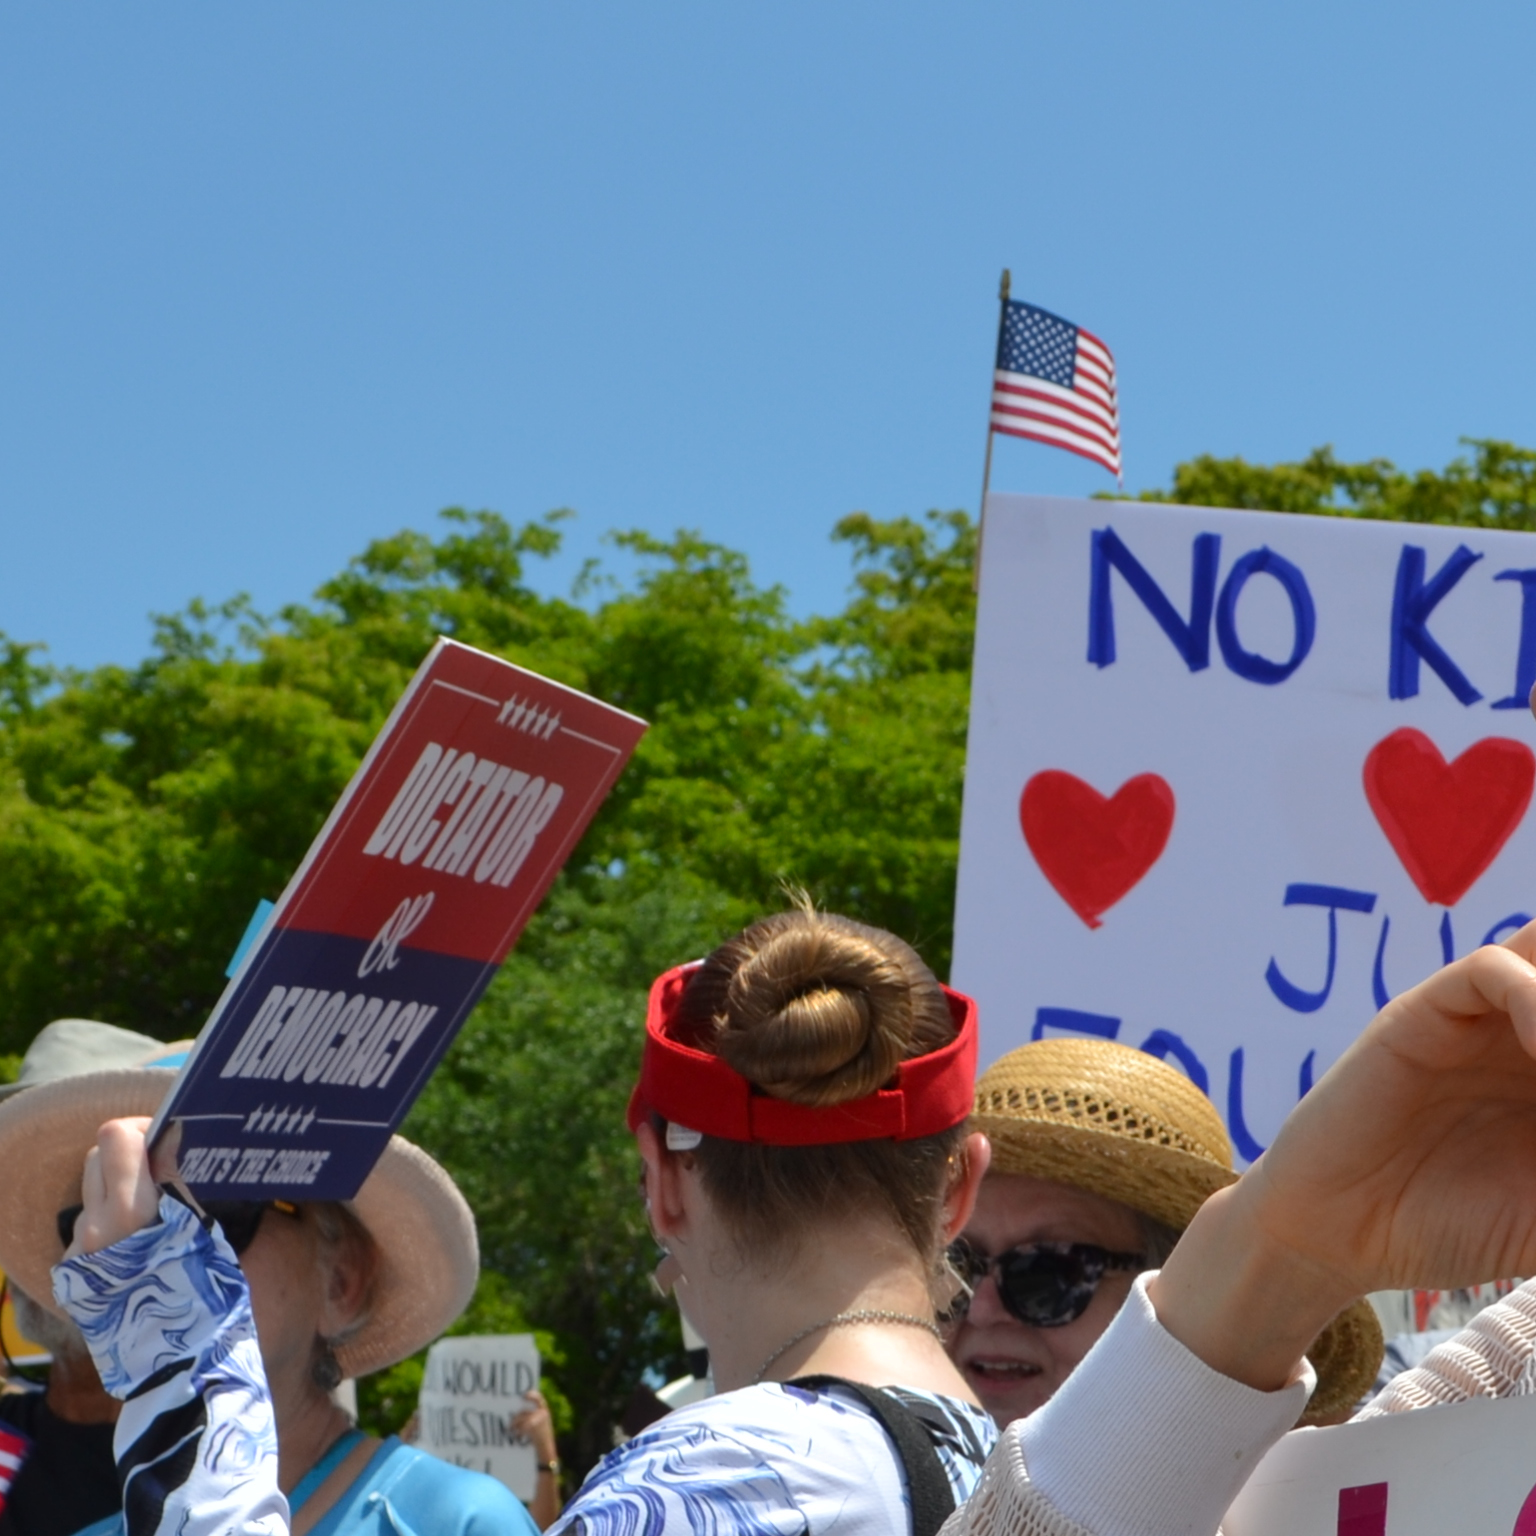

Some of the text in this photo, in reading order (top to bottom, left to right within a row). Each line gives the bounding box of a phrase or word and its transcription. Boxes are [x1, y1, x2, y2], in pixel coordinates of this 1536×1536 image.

[1086, 525, 1317, 686] NO
[363, 741, 564, 887] DICTATOR
[220, 984, 438, 1089] DEMOCRACY
[228, 1148, 276, 1184] THE
[261, 1149, 332, 1185] CHOICE
[441, 1358, 535, 1397] WOULD
